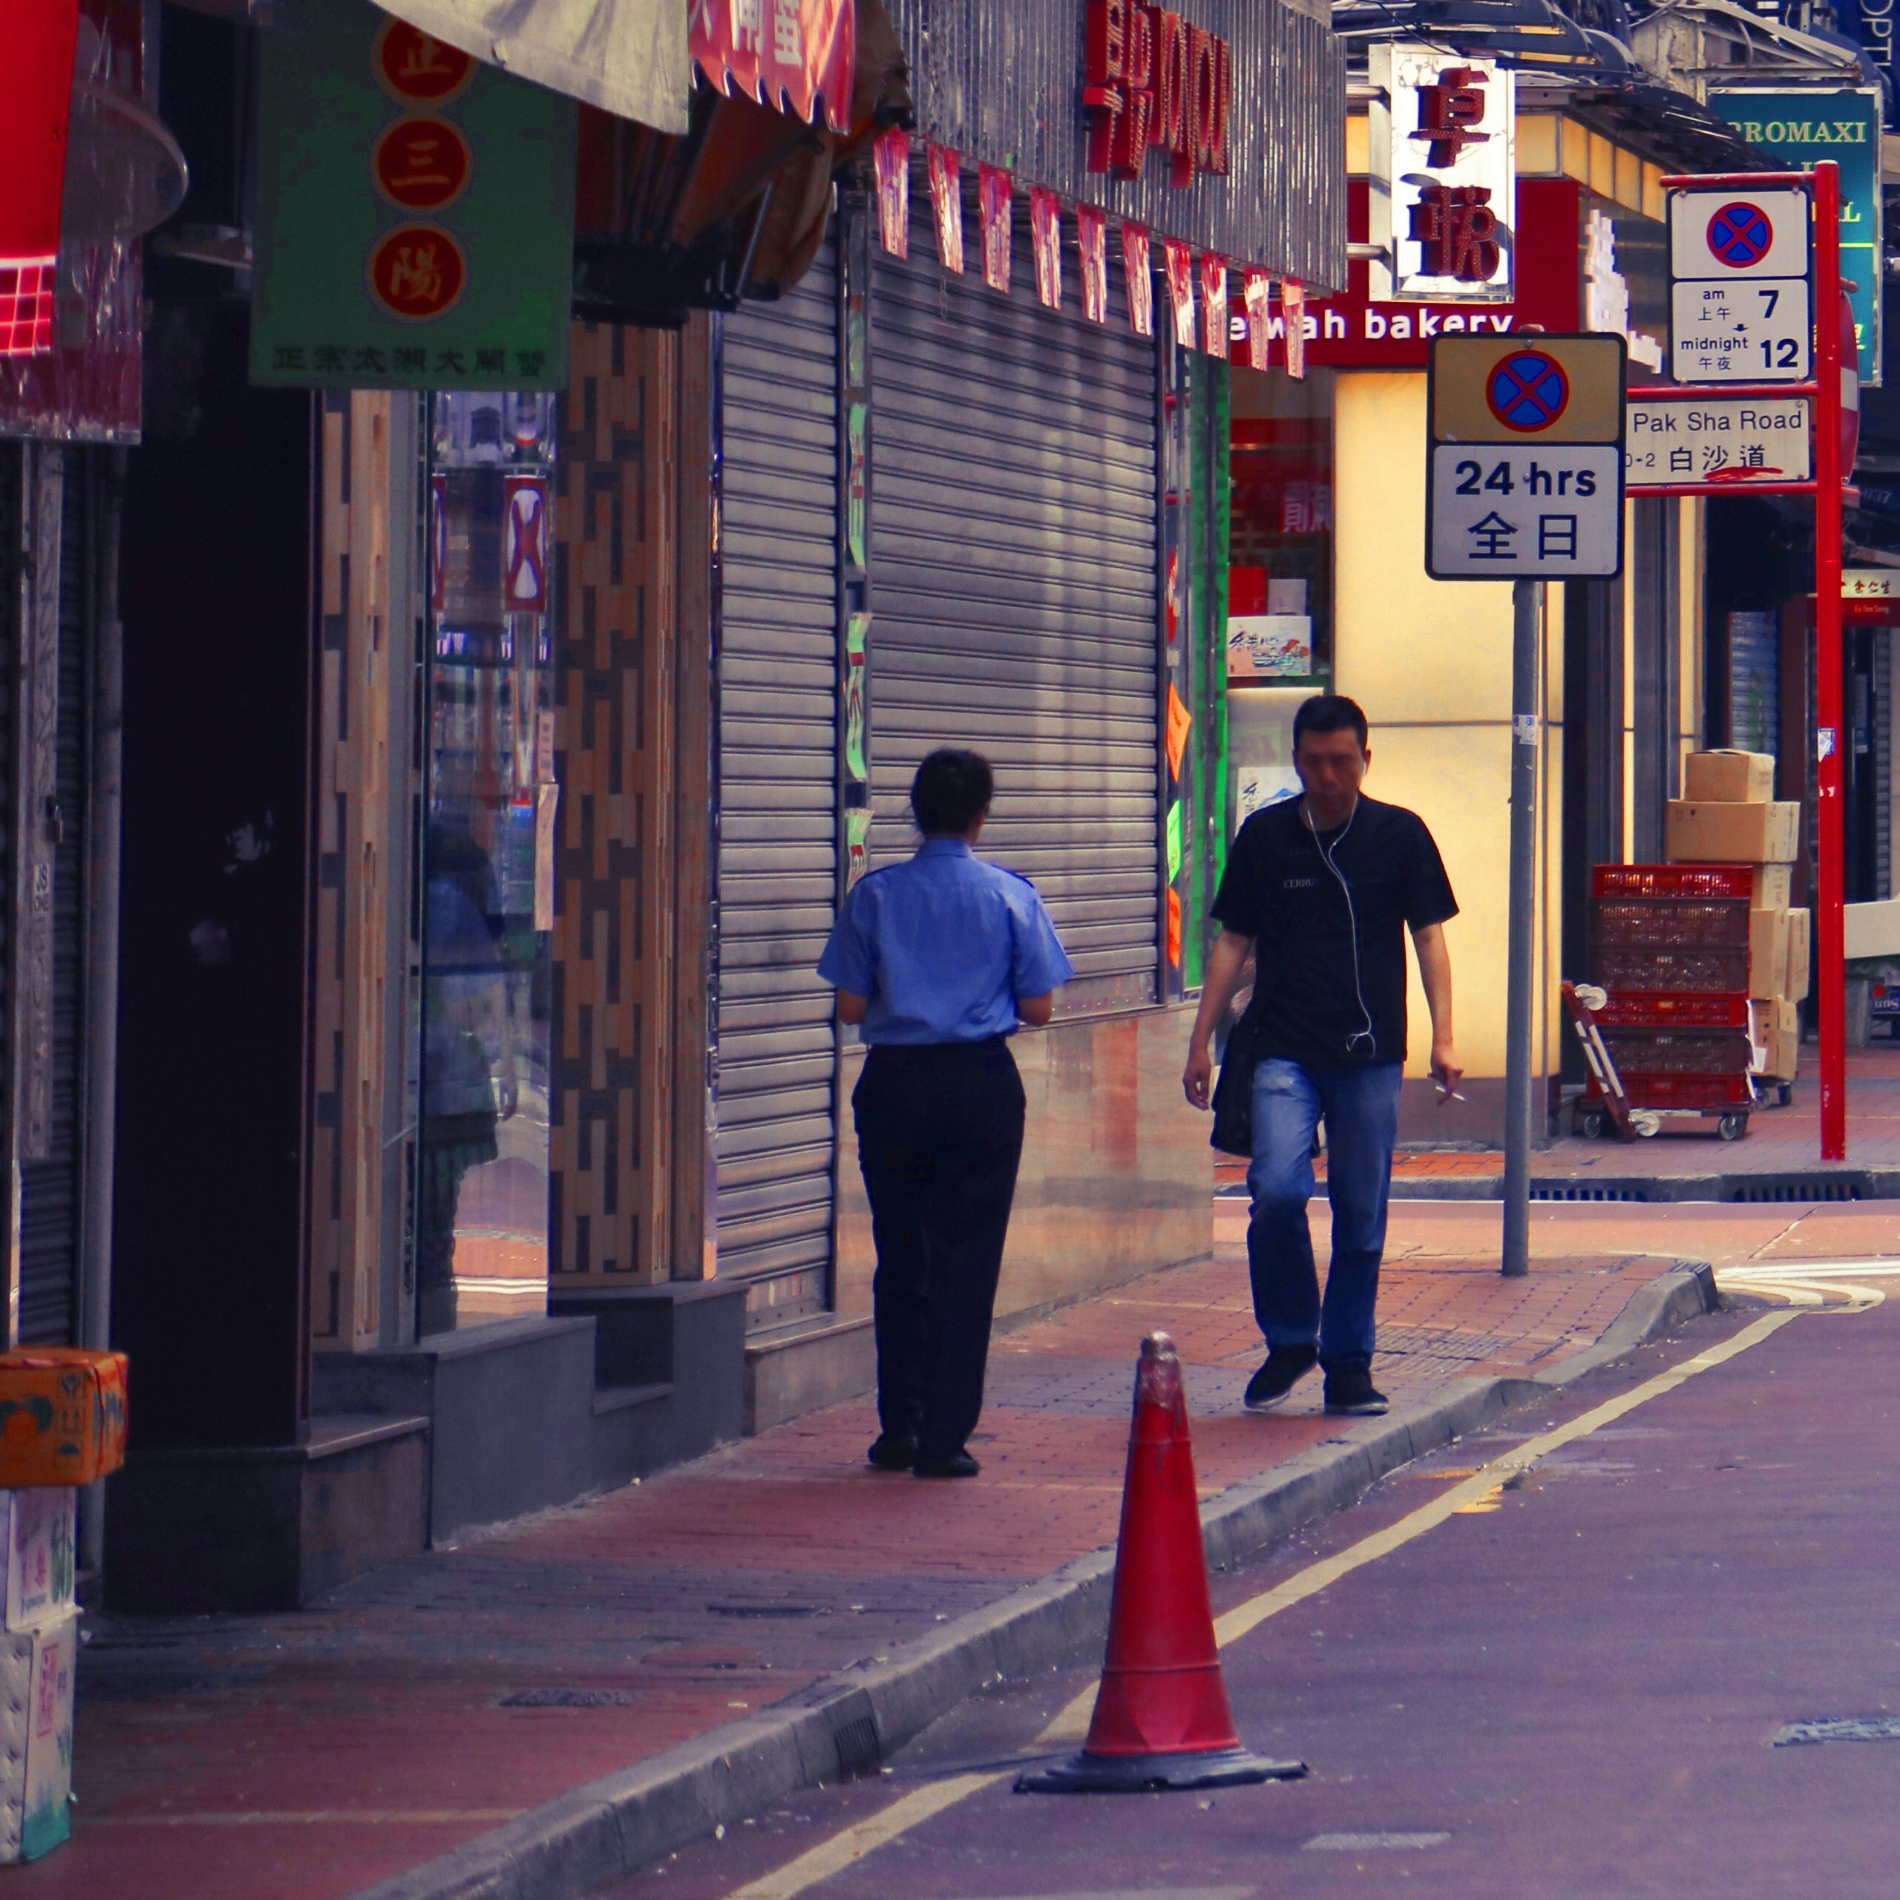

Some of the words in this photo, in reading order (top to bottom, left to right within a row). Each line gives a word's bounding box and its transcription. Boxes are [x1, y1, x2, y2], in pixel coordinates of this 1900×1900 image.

[1697, 305, 1732, 322] 上午
[1702, 288, 1726, 301] am
[1757, 289, 1781, 319] 7
[1364, 308, 1515, 340] bakery
[272, 343, 548, 379] 正宗太湖大閘蟹
[1681, 335, 1750, 354] midnight
[1758, 338, 1800, 370] 12
[1697, 355, 1733, 372] 午夜
[1632, 412, 1678, 434] Pak
[1686, 410, 1731, 433] Sha
[1739, 409, 1803, 431] Road
[1454, 459, 1515, 498] 24
[1528, 460, 1597, 498] hrs
[1466, 510, 1579, 561] 全日
